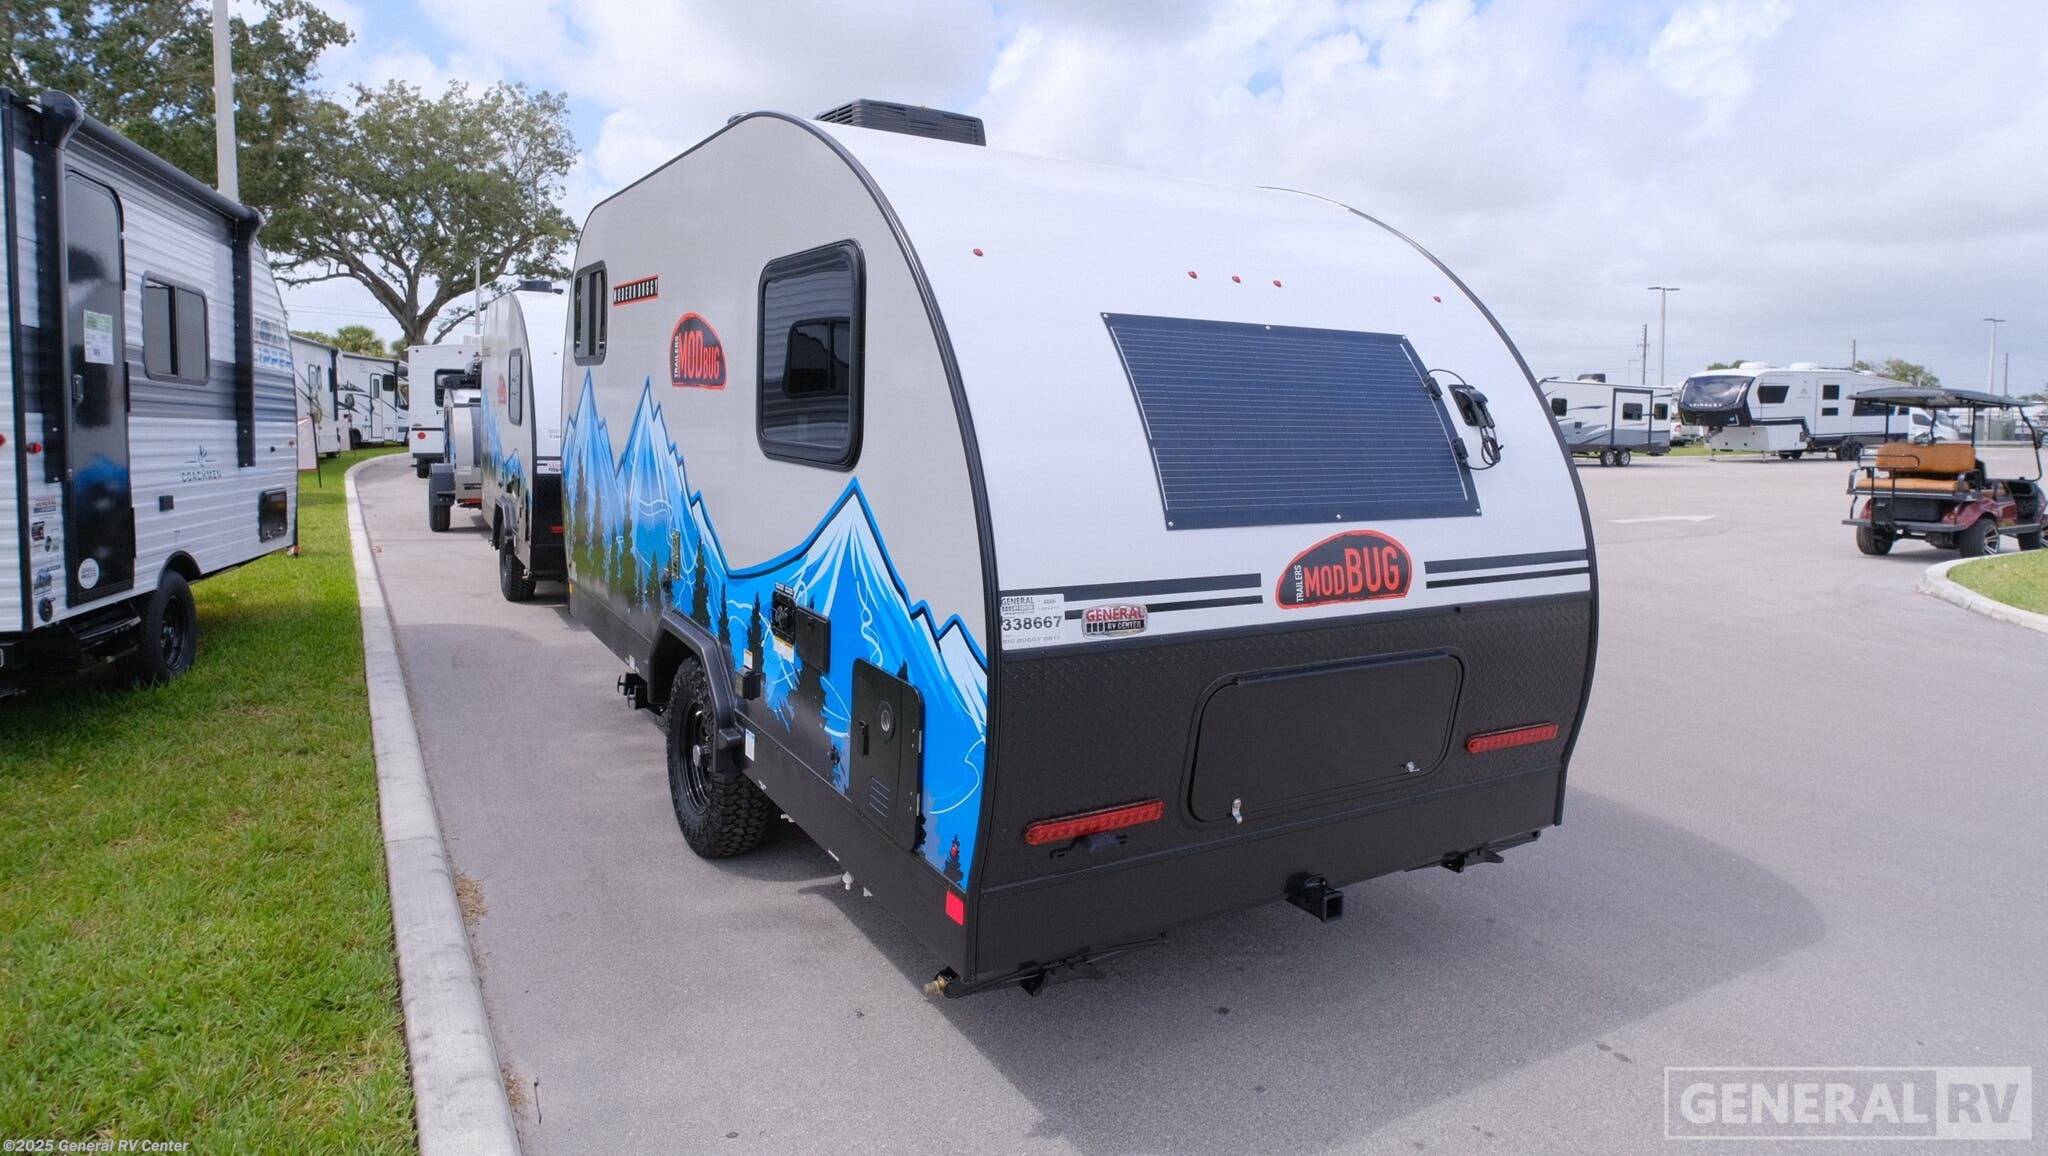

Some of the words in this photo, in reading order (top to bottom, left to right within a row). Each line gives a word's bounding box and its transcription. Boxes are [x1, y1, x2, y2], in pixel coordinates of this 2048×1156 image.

[1294, 564, 1304, 603] TRAILERS
[1002, 596, 1035, 606] GENERAL
[1086, 605, 1145, 622] GENERAL
[1002, 615, 1062, 632] 338667
